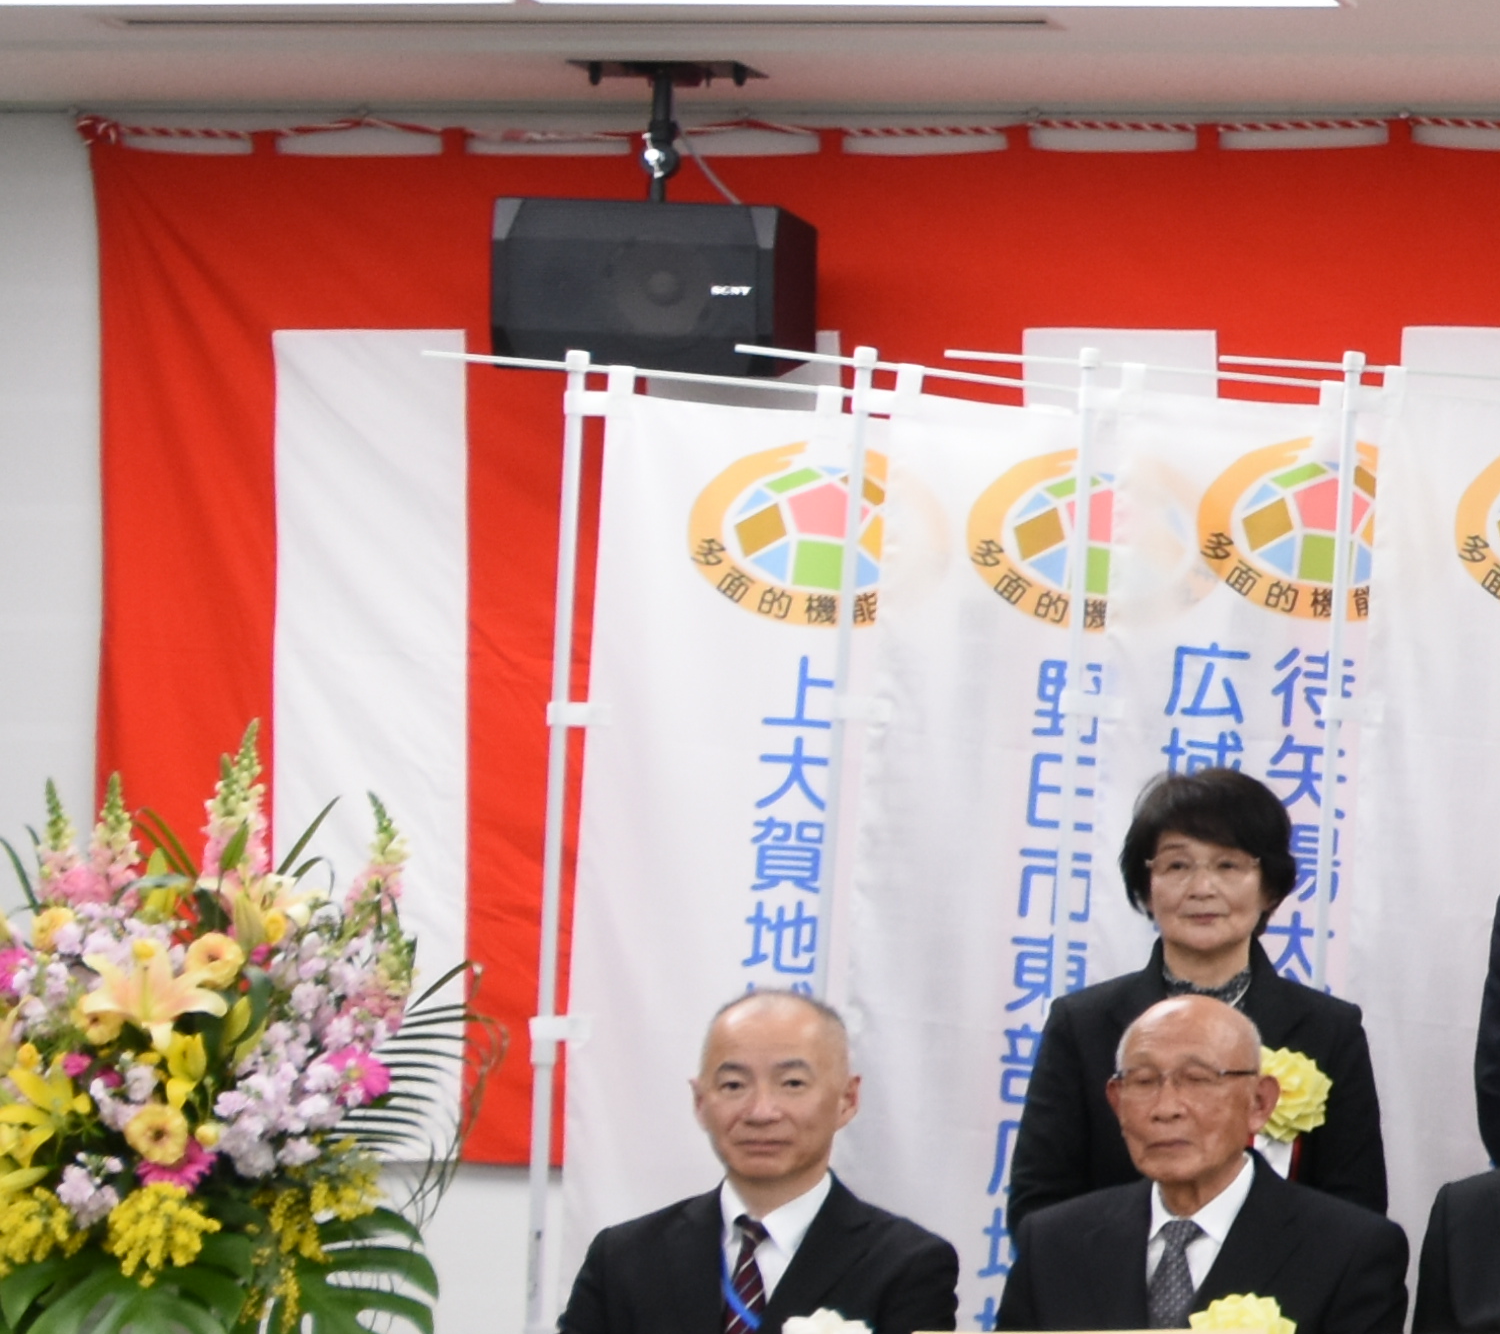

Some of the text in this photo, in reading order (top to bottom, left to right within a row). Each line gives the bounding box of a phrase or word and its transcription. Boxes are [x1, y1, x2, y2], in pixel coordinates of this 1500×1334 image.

[710, 285, 752, 296] SONY
[742, 656, 834, 1001] 上大賀地
